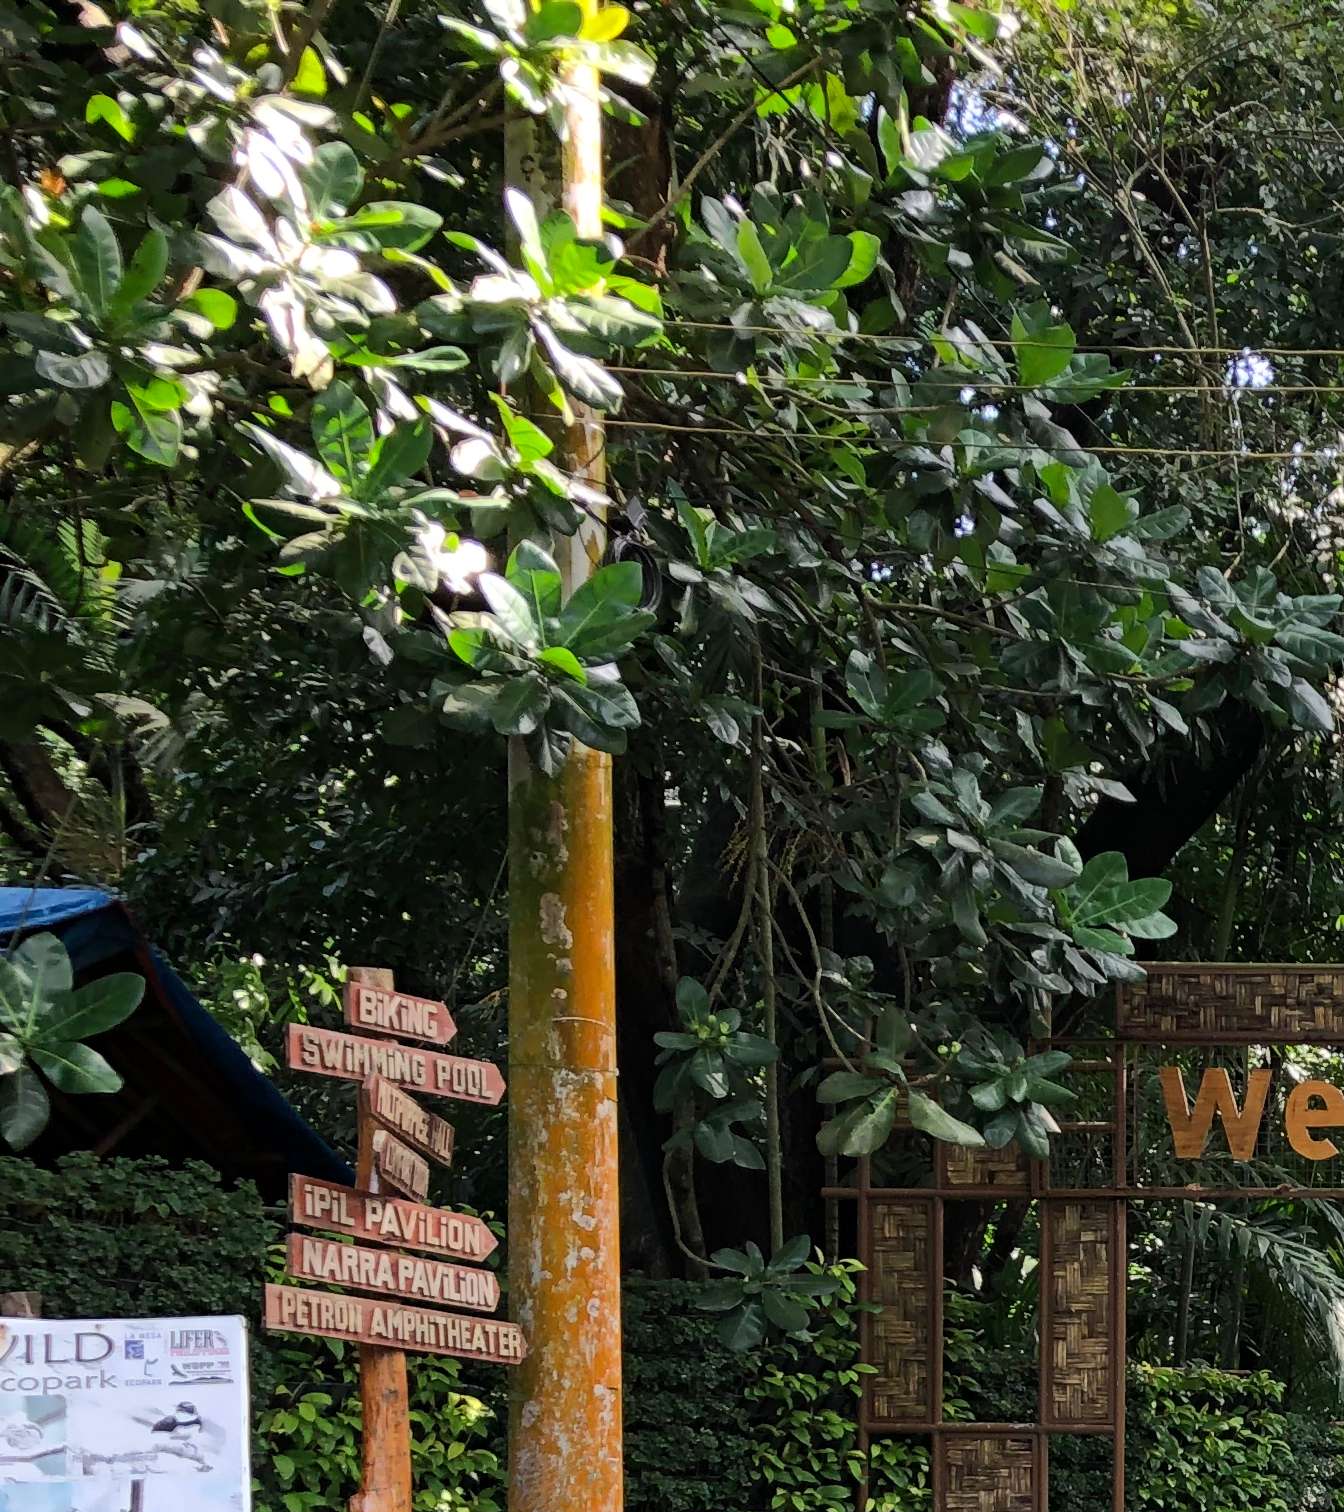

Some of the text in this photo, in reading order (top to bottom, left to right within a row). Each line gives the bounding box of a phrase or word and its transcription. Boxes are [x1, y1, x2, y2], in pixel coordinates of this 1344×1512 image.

[435, 1059, 494, 1099] POOL
[302, 1239, 396, 1291] NARRA
[281, 1291, 364, 1334] PETRON
